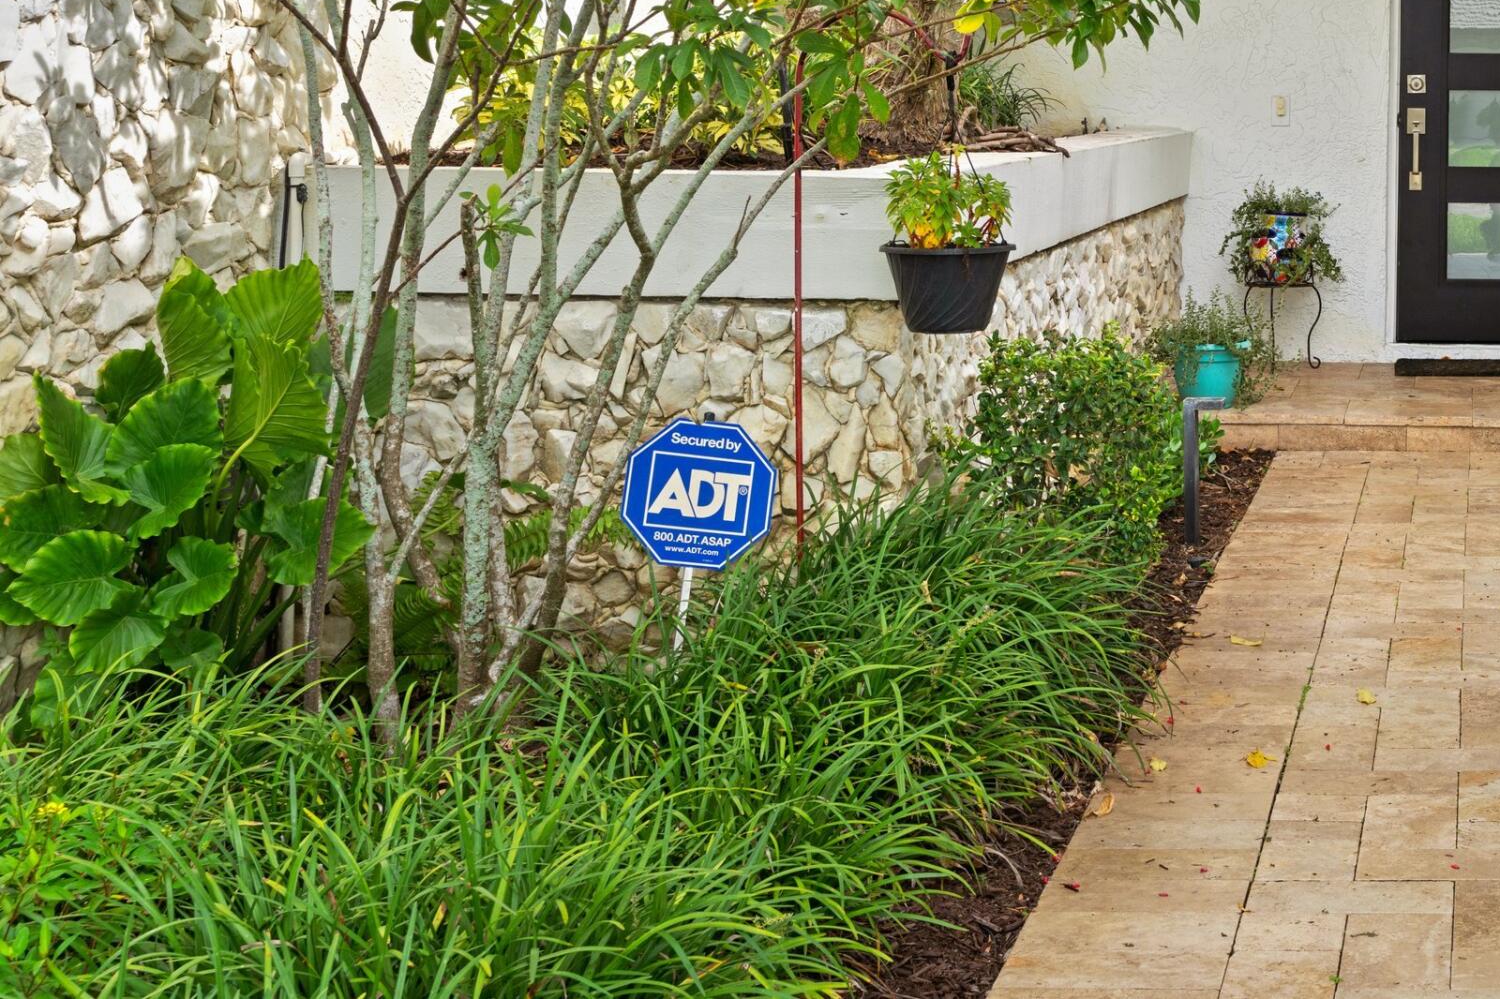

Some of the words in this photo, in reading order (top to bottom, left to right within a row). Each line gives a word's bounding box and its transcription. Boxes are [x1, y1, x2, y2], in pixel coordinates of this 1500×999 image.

[671, 432, 725, 450] Secured
[725, 436, 742, 453] by
[648, 467, 751, 522] ADT
[653, 531, 732, 547] 800.ADT.ASAP
[664, 545, 719, 557] www.ADT.com
